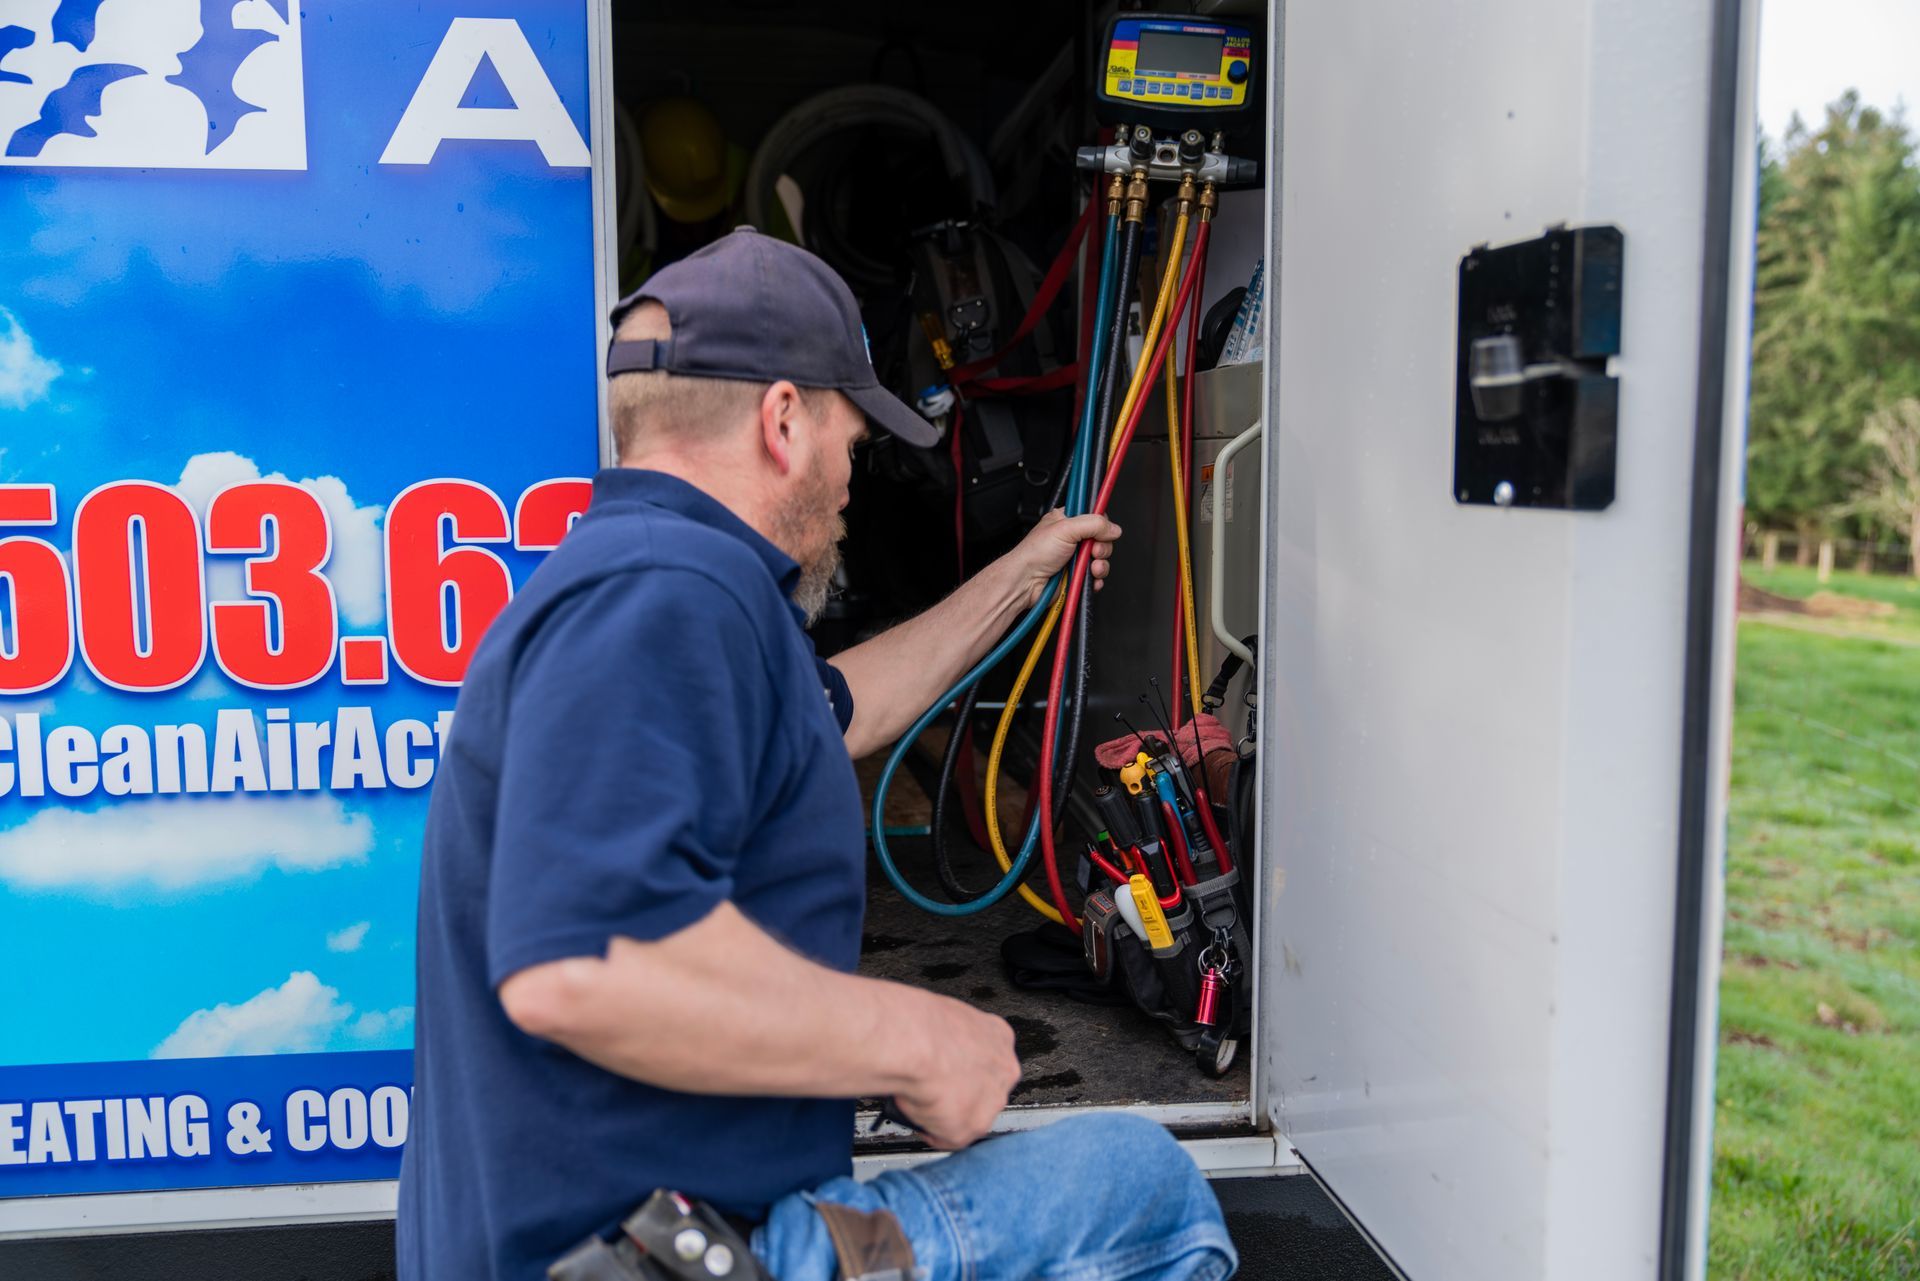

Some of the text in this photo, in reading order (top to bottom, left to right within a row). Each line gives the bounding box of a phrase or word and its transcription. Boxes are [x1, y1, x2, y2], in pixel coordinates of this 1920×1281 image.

[378, 17, 591, 168] A
[0, 706, 455, 798] leanAirAc
[226, 1102, 272, 1155] &
[286, 1086, 415, 1152] COO
